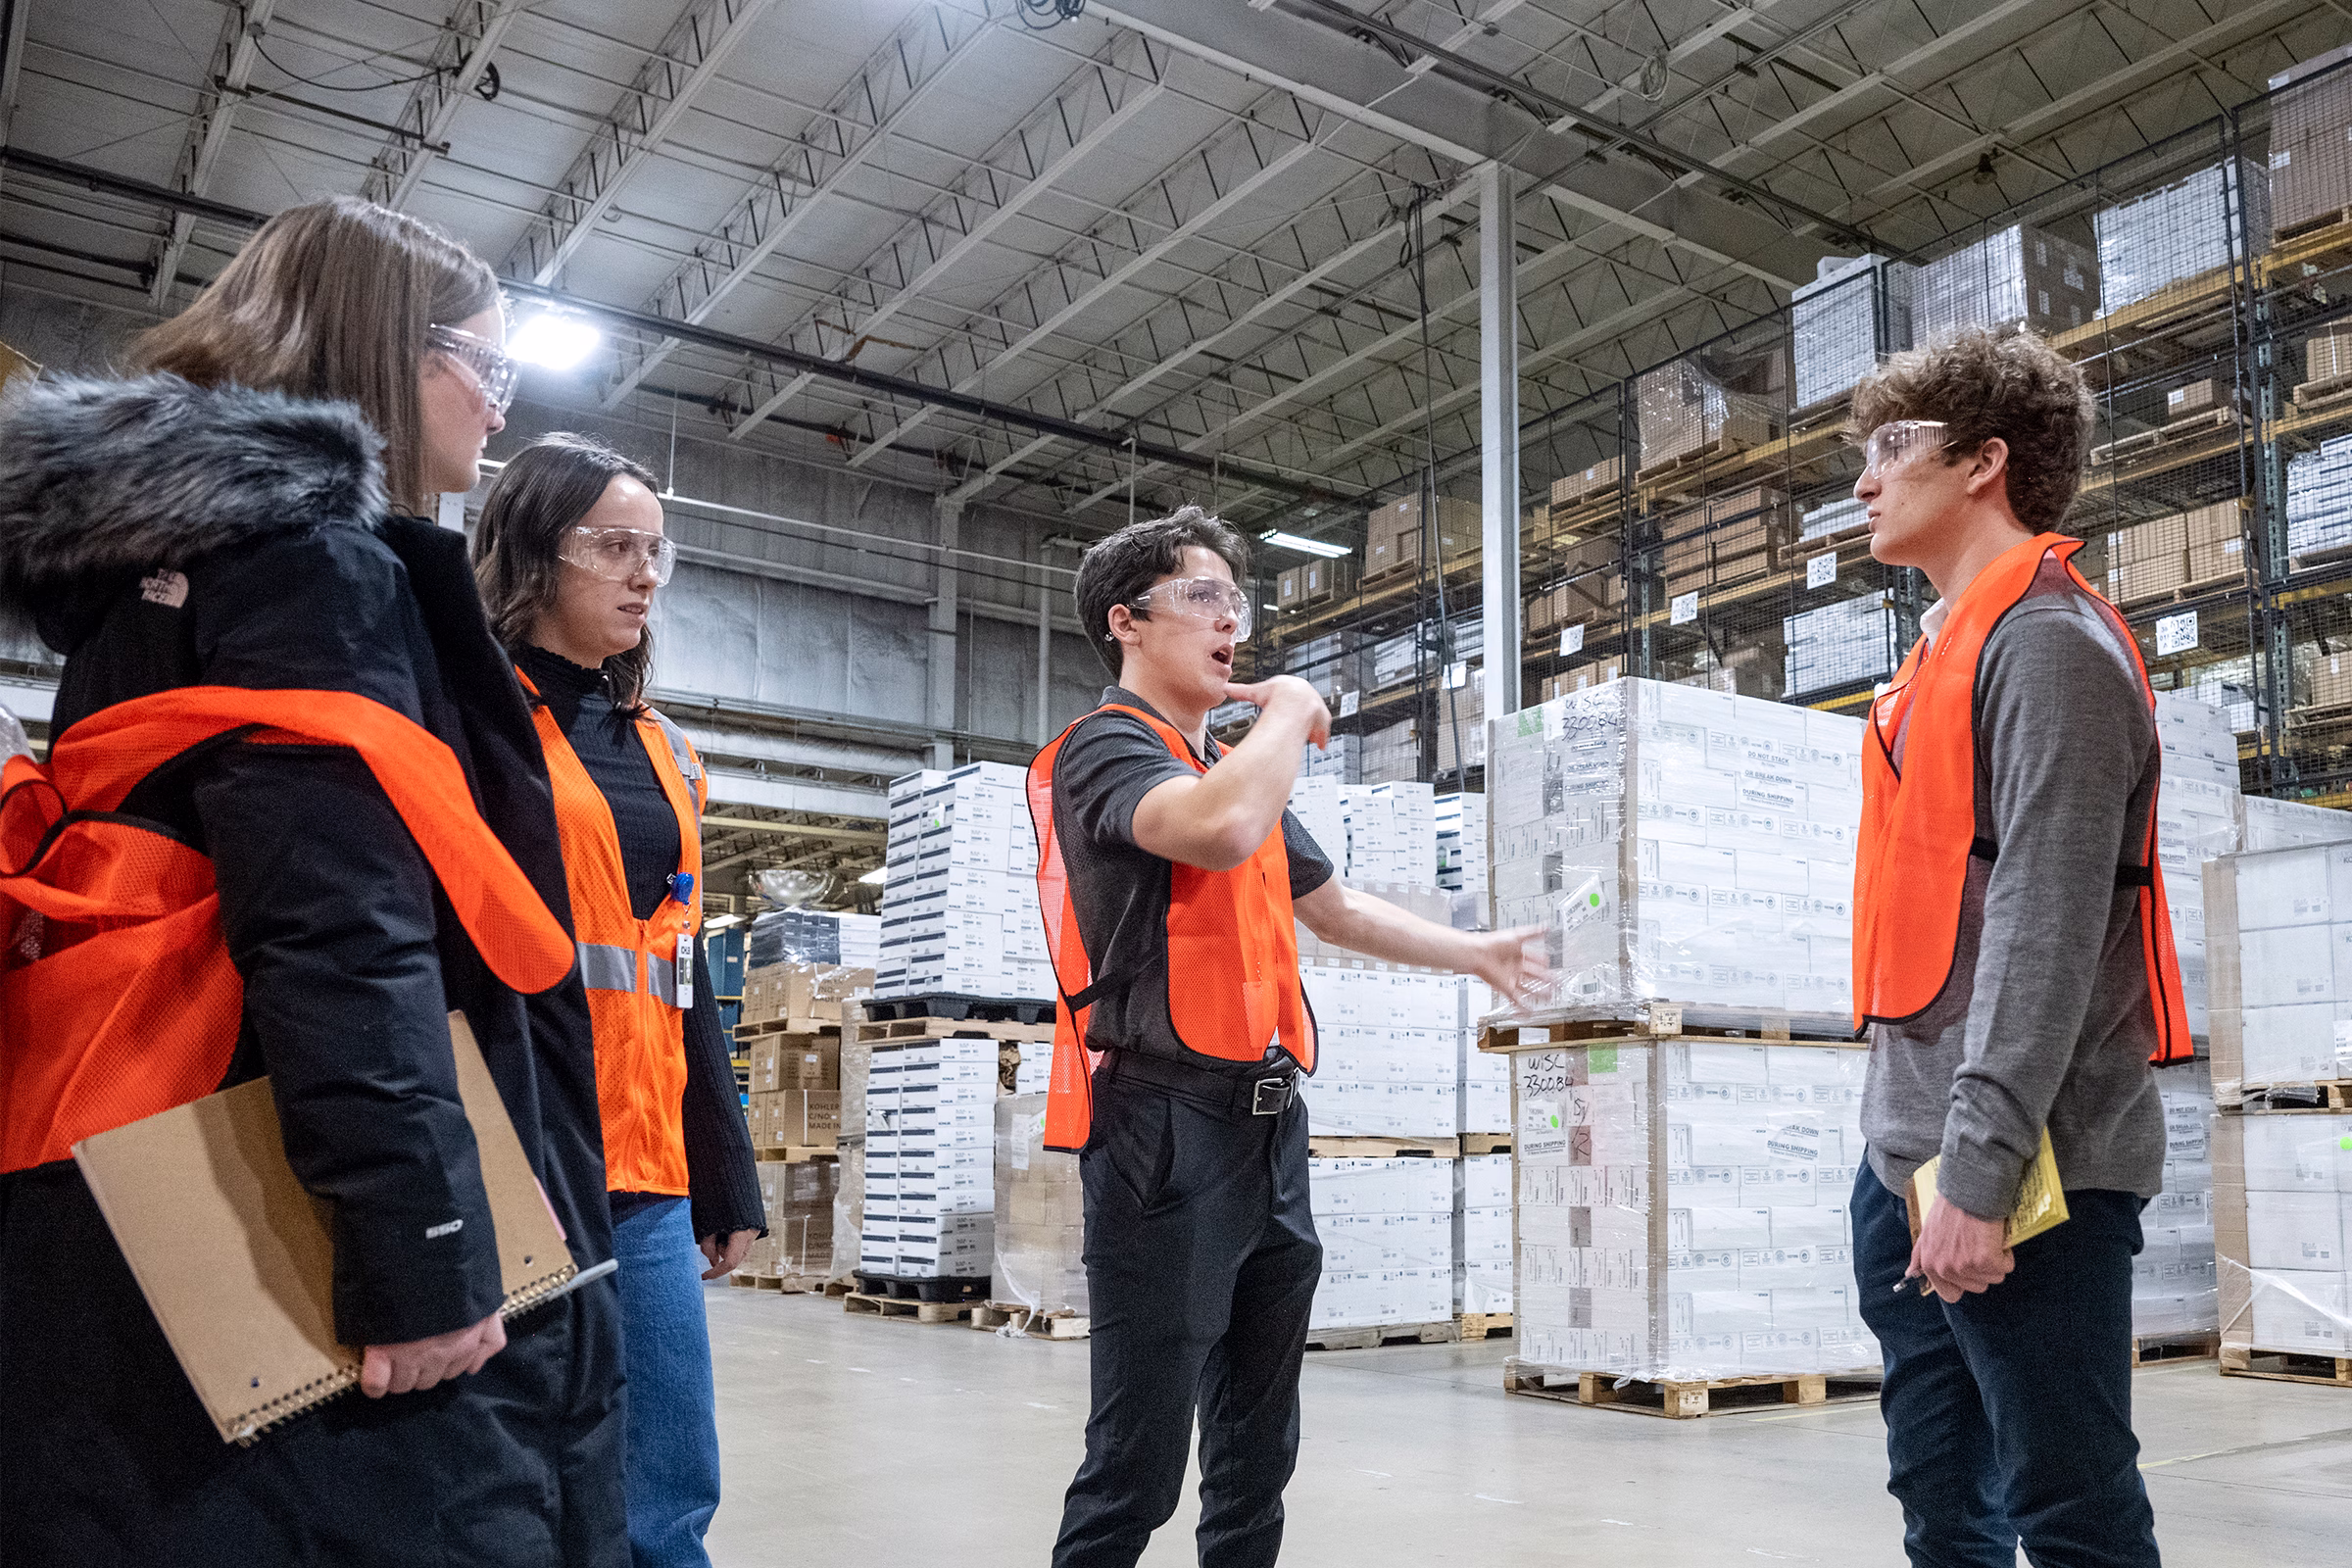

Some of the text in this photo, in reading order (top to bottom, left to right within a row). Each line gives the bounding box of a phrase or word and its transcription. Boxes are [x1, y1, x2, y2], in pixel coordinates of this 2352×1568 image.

[1771, 755, 1789, 763] STACK
[1755, 771, 1774, 780] BREAK
[1742, 788, 1765, 797] DURING
[1767, 793, 1794, 803] SHIPPING
[1523, 1075, 1574, 1098] 330084
[1802, 1127, 1819, 1135] DOWN
[1524, 1139, 1566, 1150] DURING SHIPPING
[1767, 1140, 1790, 1150] DURING
[1791, 1145, 1818, 1155] SHIPPING
